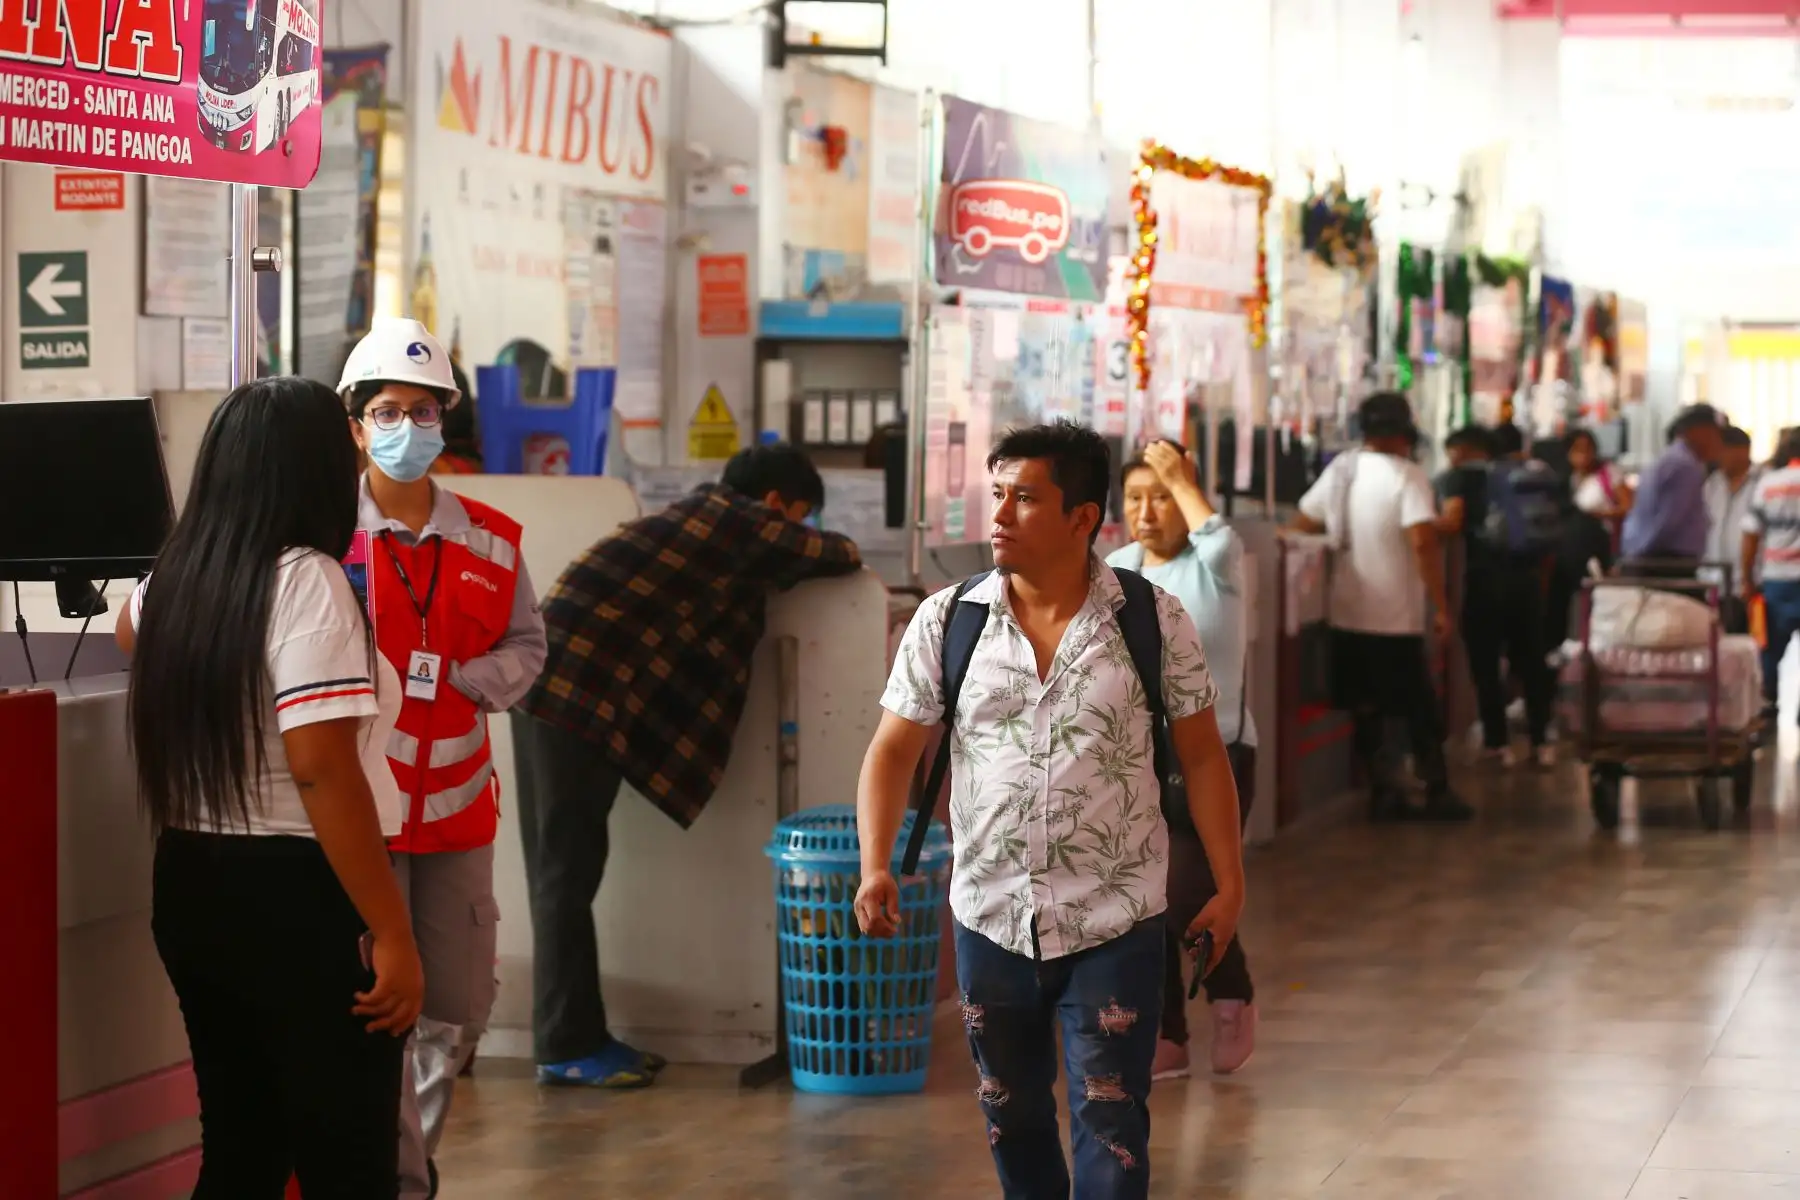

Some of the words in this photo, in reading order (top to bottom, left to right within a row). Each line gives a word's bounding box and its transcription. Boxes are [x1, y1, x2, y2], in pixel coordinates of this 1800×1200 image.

[84, 85, 138, 119] SANTA
[142, 93, 175, 123] ANA
[487, 35, 660, 182] MIBUS
[11, 117, 86, 154] MARTIN
[92, 126, 116, 157] DE
[121, 129, 192, 164] PANGOA
[959, 197, 1061, 231] redBus.pe
[23, 340, 87, 360] SALIDA
